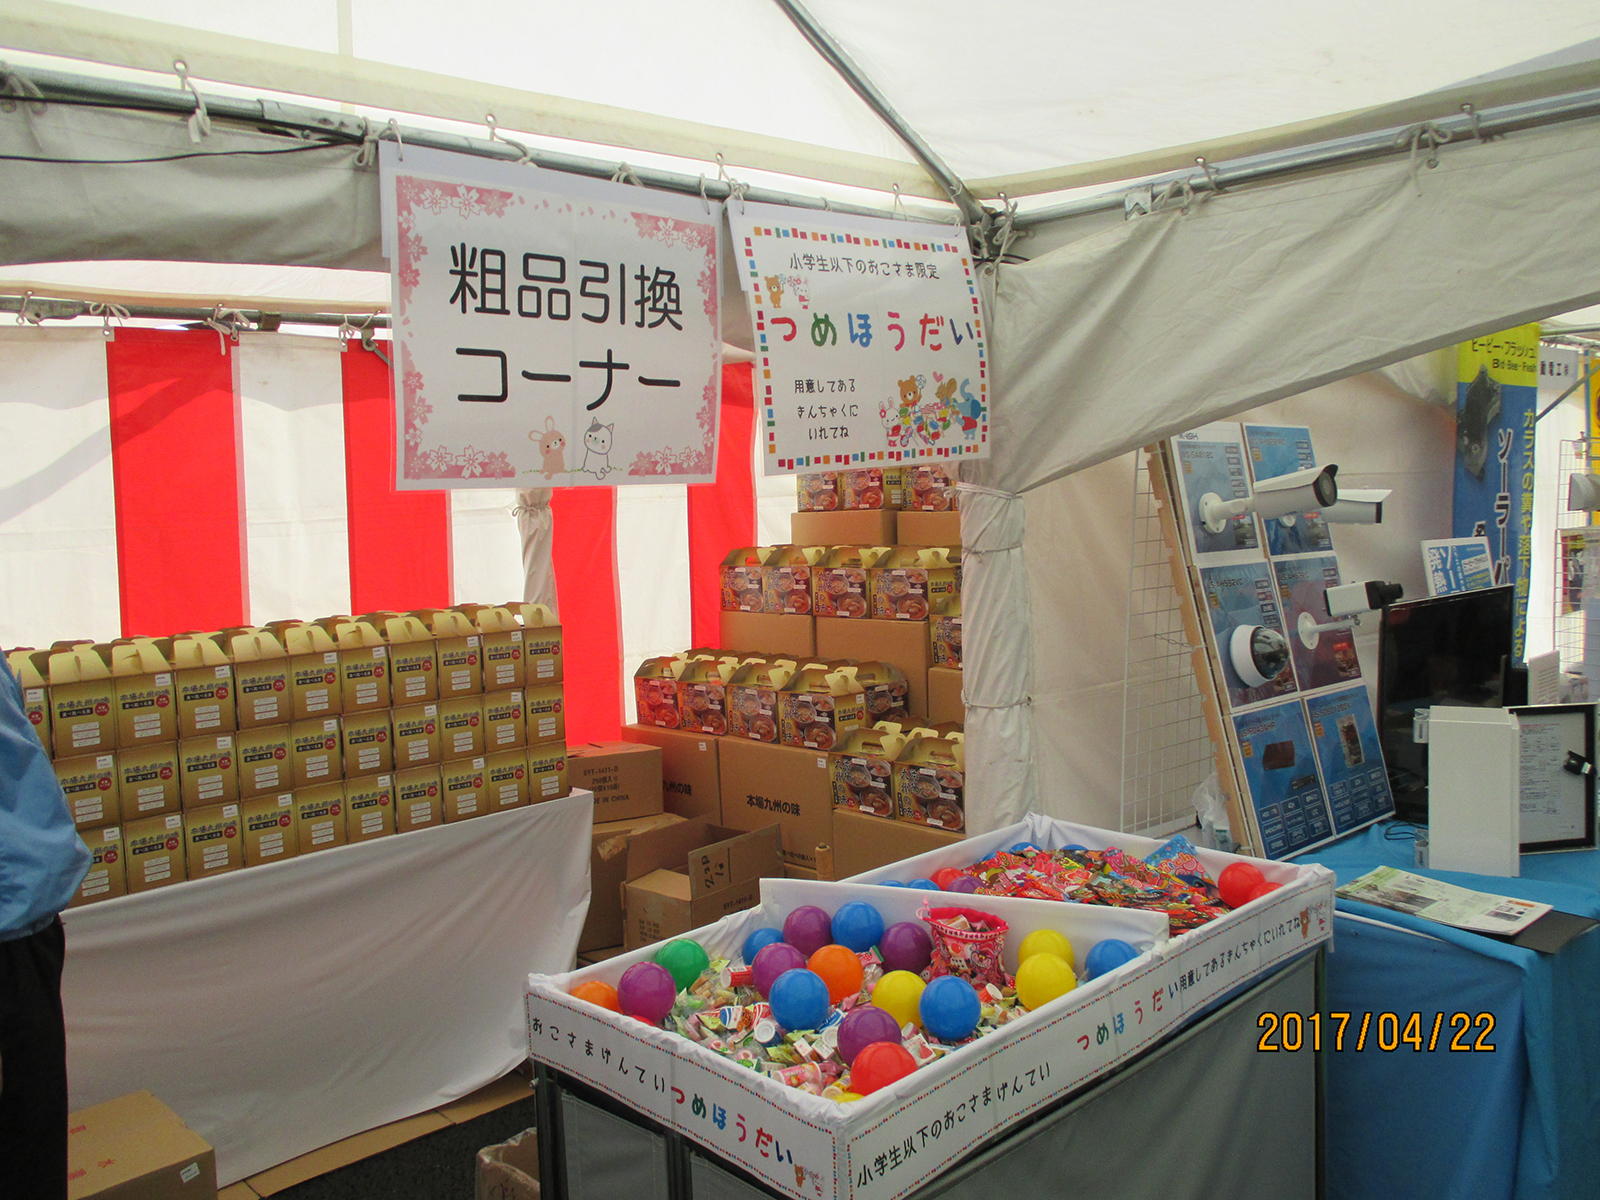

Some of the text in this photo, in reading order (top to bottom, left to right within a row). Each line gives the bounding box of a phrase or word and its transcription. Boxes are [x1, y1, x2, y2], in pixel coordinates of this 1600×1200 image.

[790, 253, 940, 280] 小学生以下のおこさま限定
[449, 242, 683, 331] 粗品引換
[770, 311, 974, 352] つめほうだい
[456, 349, 681, 411] コーナー
[794, 379, 856, 394] 用意してある
[797, 404, 859, 419] きんちゃくに
[808, 426, 849, 441] いれてね
[746, 794, 801, 816] 本場九州の味
[857, 916, 1301, 1188] 小学生以下のおこさまげんてい つめほうだい 用意してあるきんちゃくにいれてね
[671, 1086, 793, 1165] つめほうだい
